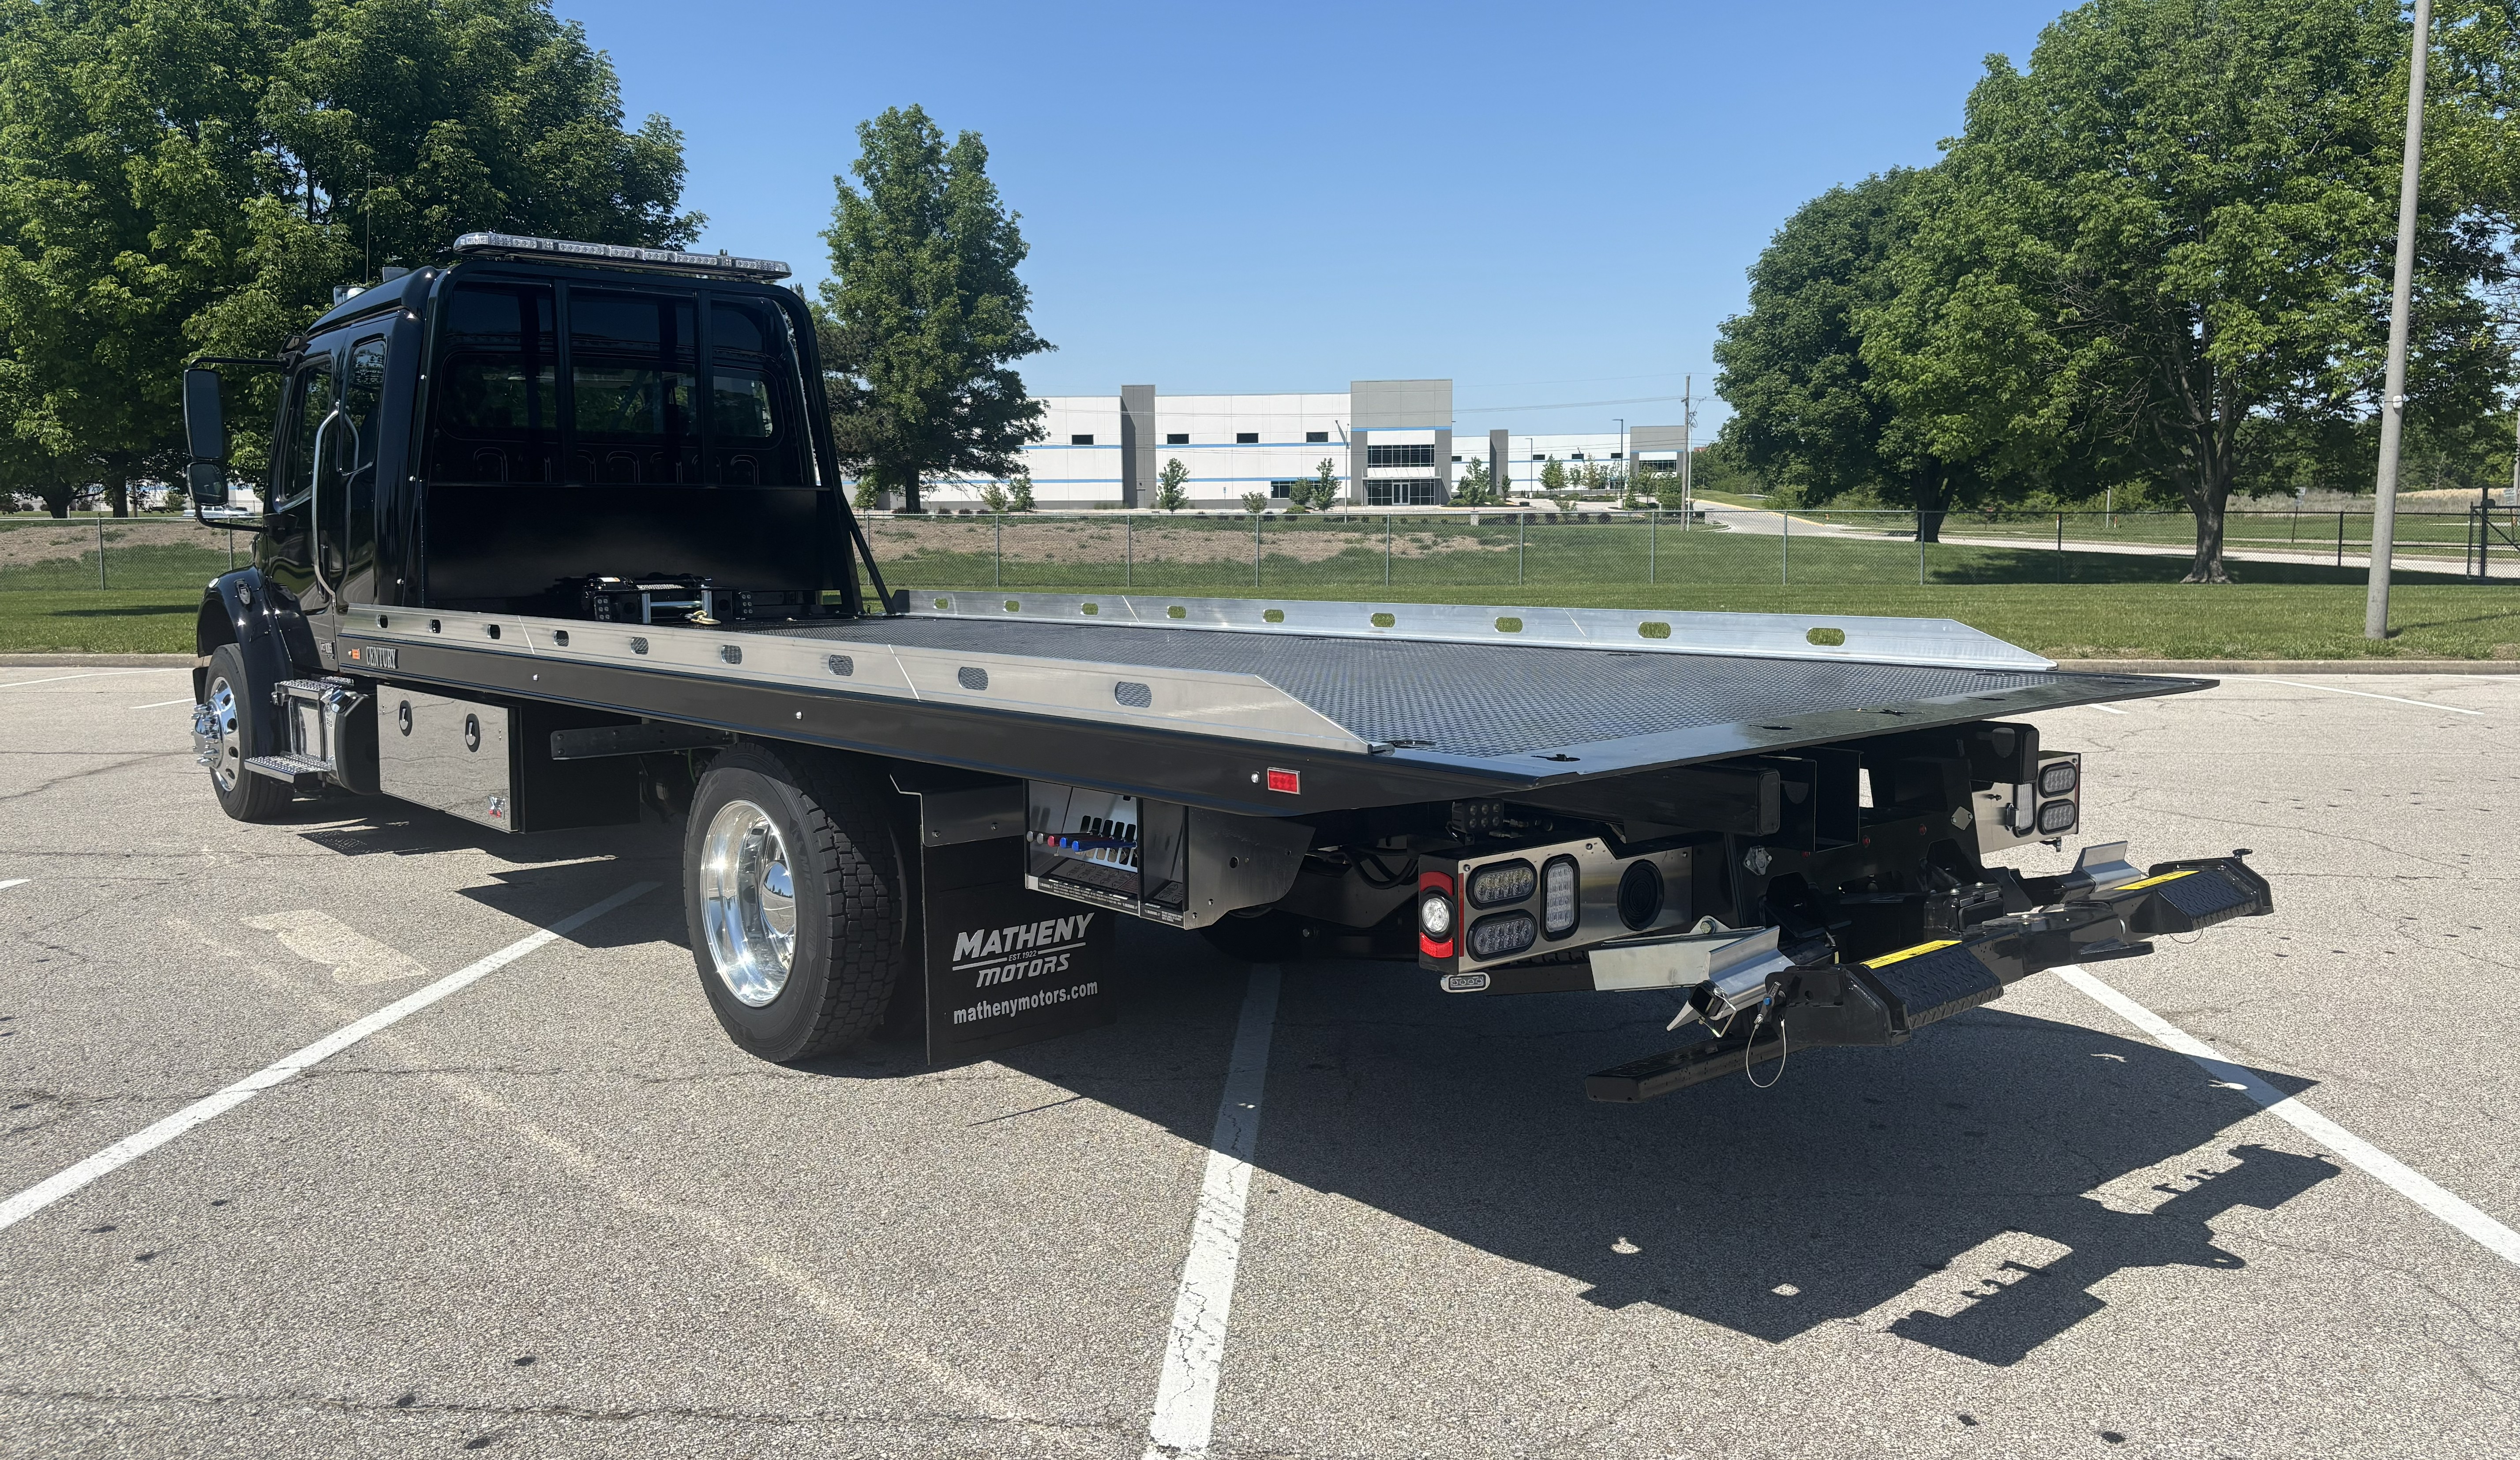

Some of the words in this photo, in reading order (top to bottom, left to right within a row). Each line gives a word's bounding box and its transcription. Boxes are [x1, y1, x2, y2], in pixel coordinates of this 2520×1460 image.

[366, 646, 396, 669] CENTURY
[953, 912, 1095, 961] MATHENY
[976, 953, 1070, 988] MOTORS
[954, 981, 1098, 1024] mathenymotors.com
